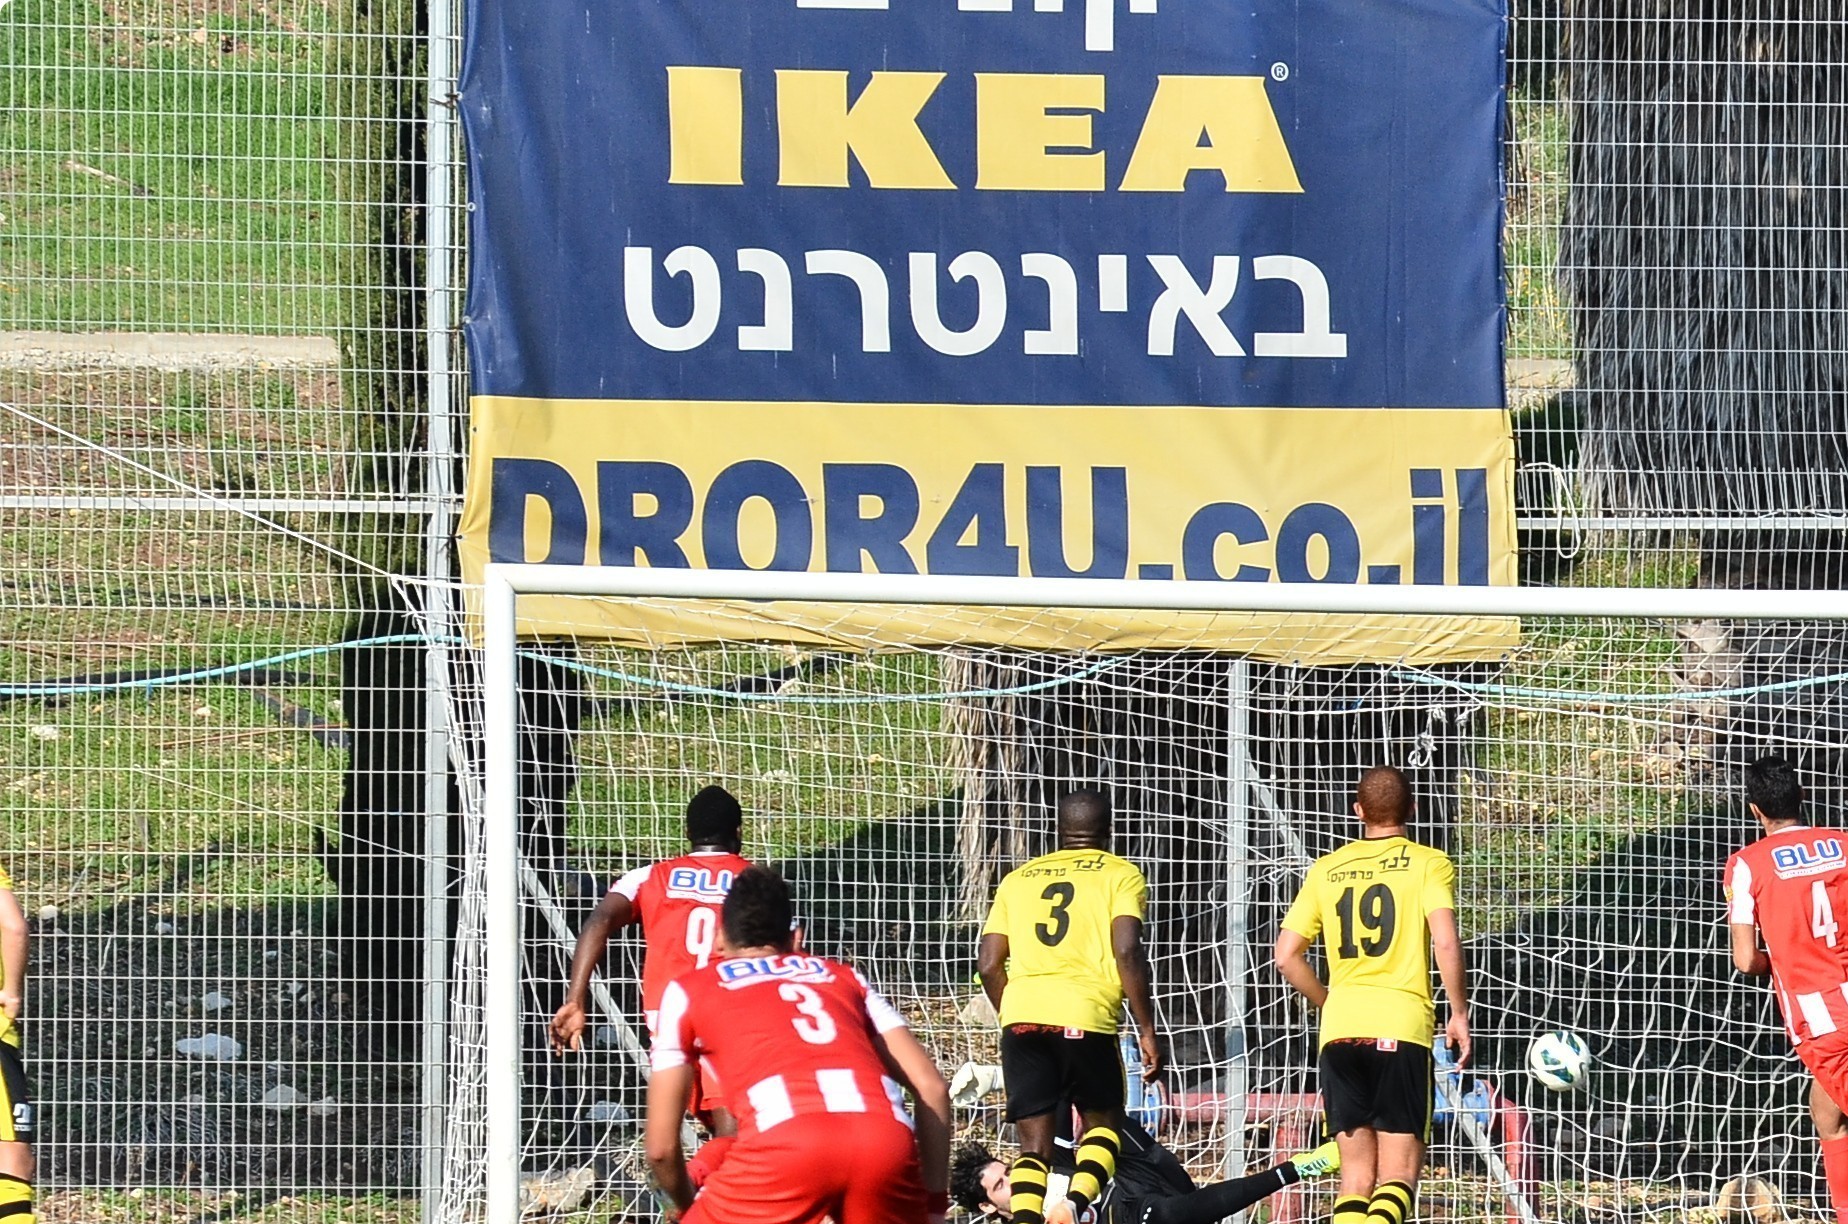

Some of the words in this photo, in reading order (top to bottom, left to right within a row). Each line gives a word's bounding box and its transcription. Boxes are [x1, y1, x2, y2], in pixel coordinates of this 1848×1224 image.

[666, 65, 1305, 194] IKEA
[622, 244, 1348, 359] באינטרנט
[490, 458, 1488, 586] DROR4U.co.il
[1772, 839, 1842, 870] BLU
[685, 906, 717, 970] 9
[1034, 881, 1075, 948] 3
[1335, 882, 1396, 960] 19
[1811, 879, 1839, 949] 4
[718, 956, 829, 982] BLU
[777, 983, 838, 1045] 3
